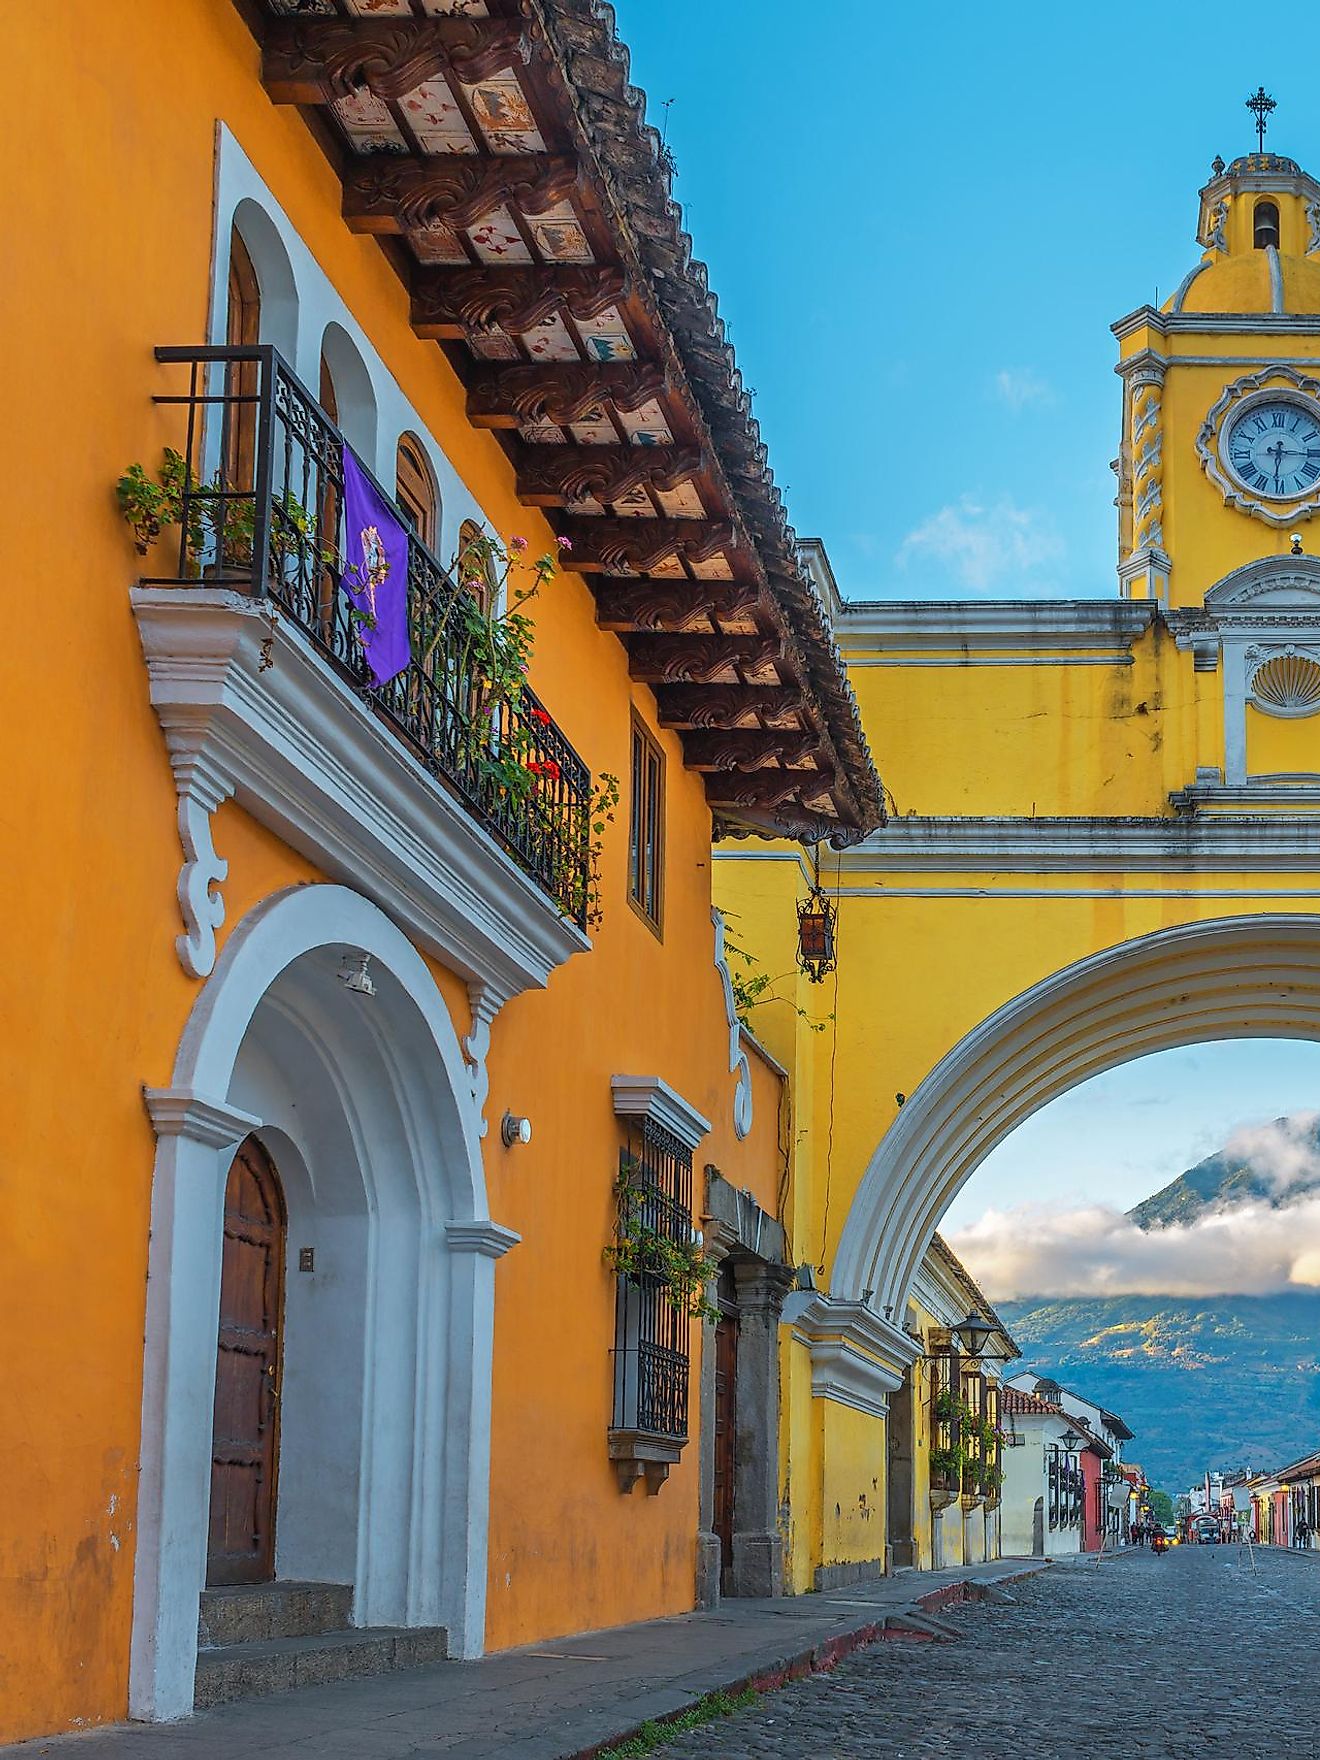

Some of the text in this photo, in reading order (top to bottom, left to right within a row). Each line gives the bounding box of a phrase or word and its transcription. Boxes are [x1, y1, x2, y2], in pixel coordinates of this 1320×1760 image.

[1252, 417, 1268, 434] XI
[1271, 413, 1286, 428] XII
[1290, 418, 1301, 432] I
[1238, 431, 1255, 444] X
[1302, 431, 1319, 442] II
[1234, 448, 1250, 460] IX
[1252, 475, 1269, 491] VII
[1274, 479, 1285, 494] VI
[1293, 475, 1304, 490] V
